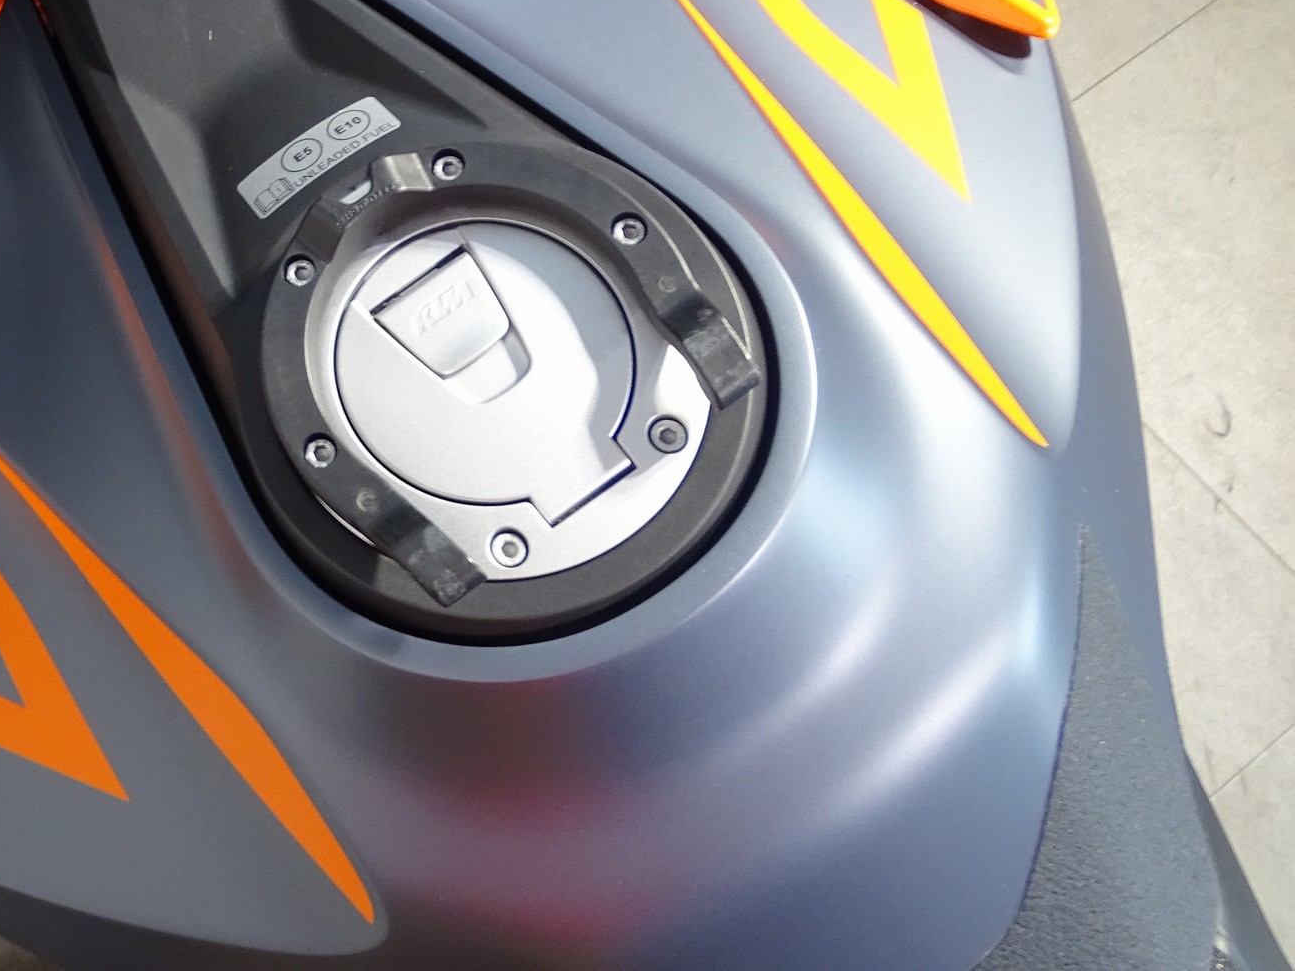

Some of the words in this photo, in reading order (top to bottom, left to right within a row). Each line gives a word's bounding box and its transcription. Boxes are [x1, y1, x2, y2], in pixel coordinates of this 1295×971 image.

[334, 116, 362, 135] E10
[293, 146, 313, 163] E5
[293, 140, 361, 187] UNLEADED
[361, 122, 397, 142] FUEL
